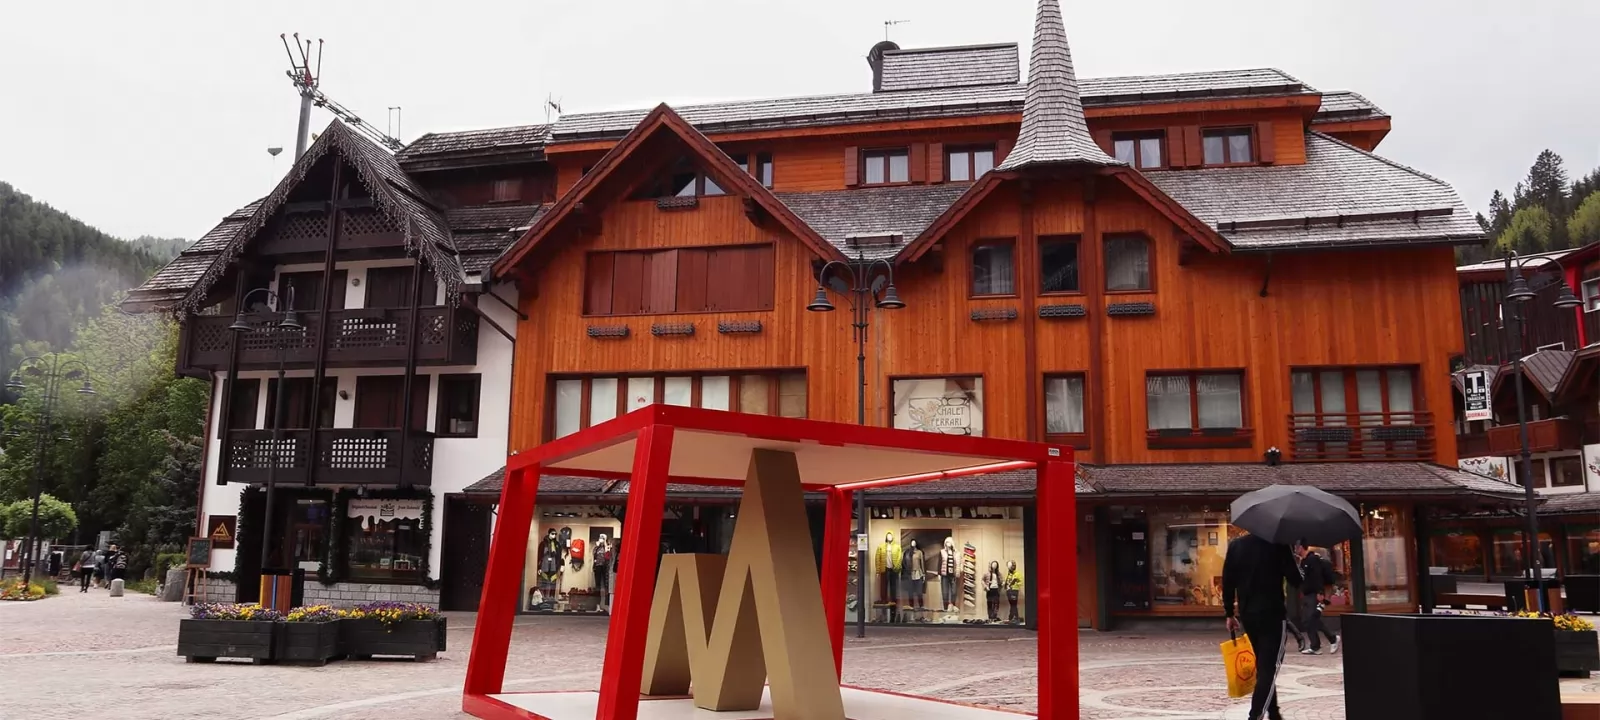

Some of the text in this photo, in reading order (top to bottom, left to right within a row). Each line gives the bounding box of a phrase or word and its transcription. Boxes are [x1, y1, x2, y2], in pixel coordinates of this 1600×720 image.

[1467, 372, 1482, 393] T
[937, 406, 965, 416] CHALET
[931, 418, 962, 426] FERRARI
